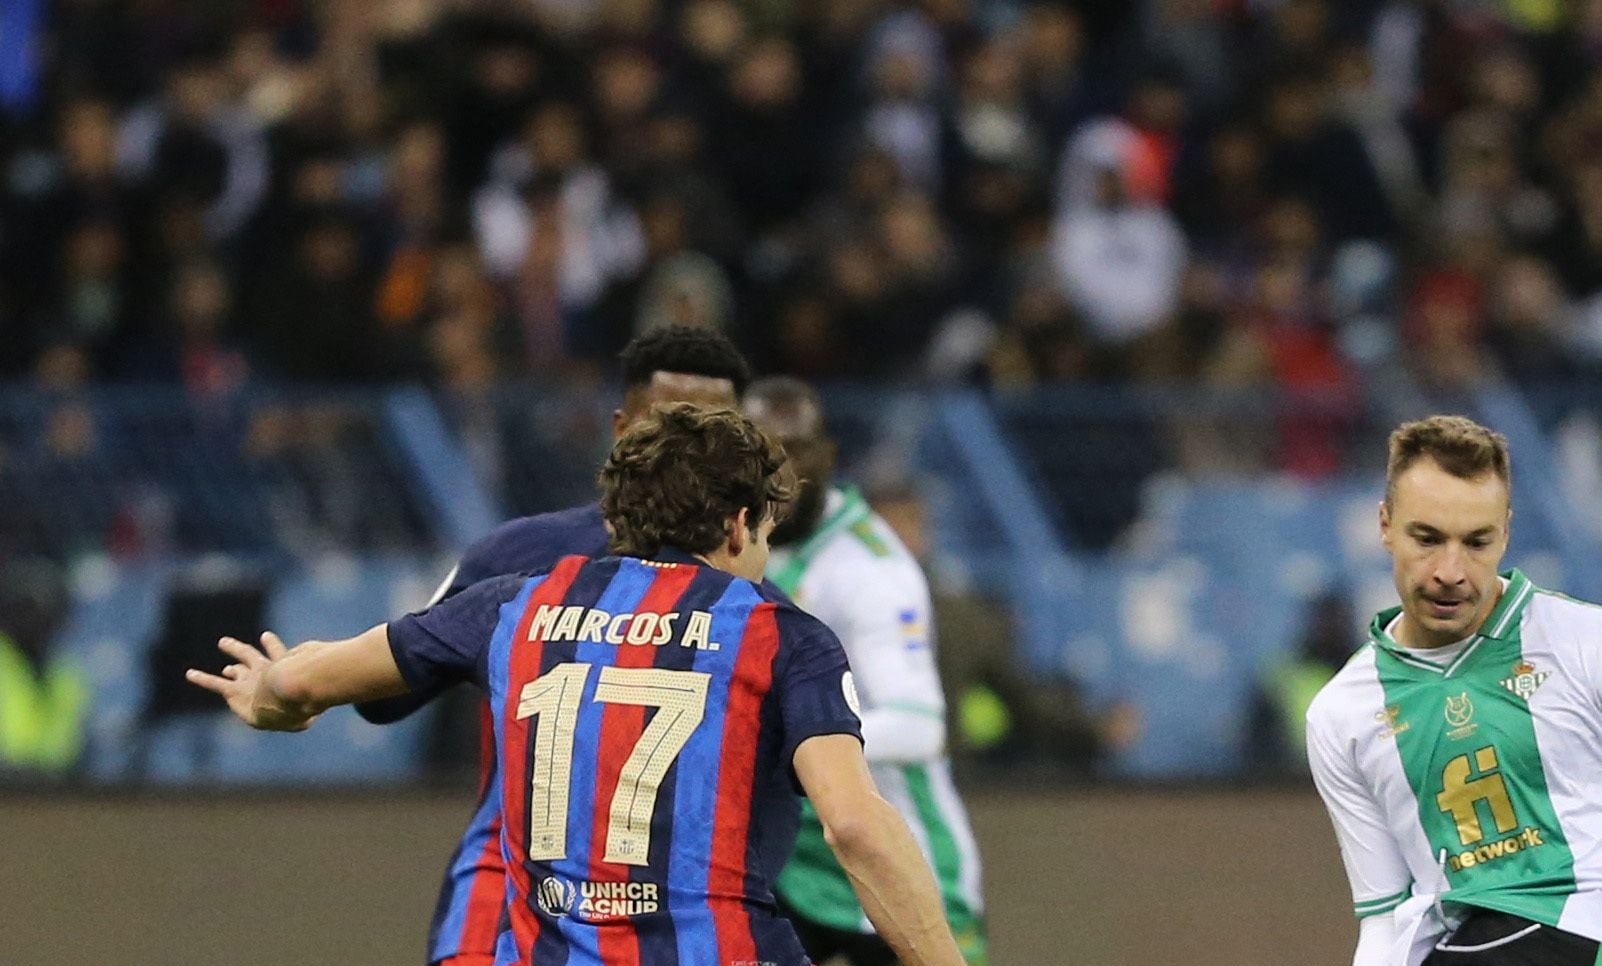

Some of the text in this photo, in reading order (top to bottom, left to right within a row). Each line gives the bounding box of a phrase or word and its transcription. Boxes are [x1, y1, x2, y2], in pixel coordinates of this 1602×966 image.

[527, 604, 720, 651] MARCOS A.
[516, 662, 713, 867] 17
[1435, 744, 1519, 847] fi
[1449, 825, 1545, 873] network
[580, 881, 660, 901] UNHCR
